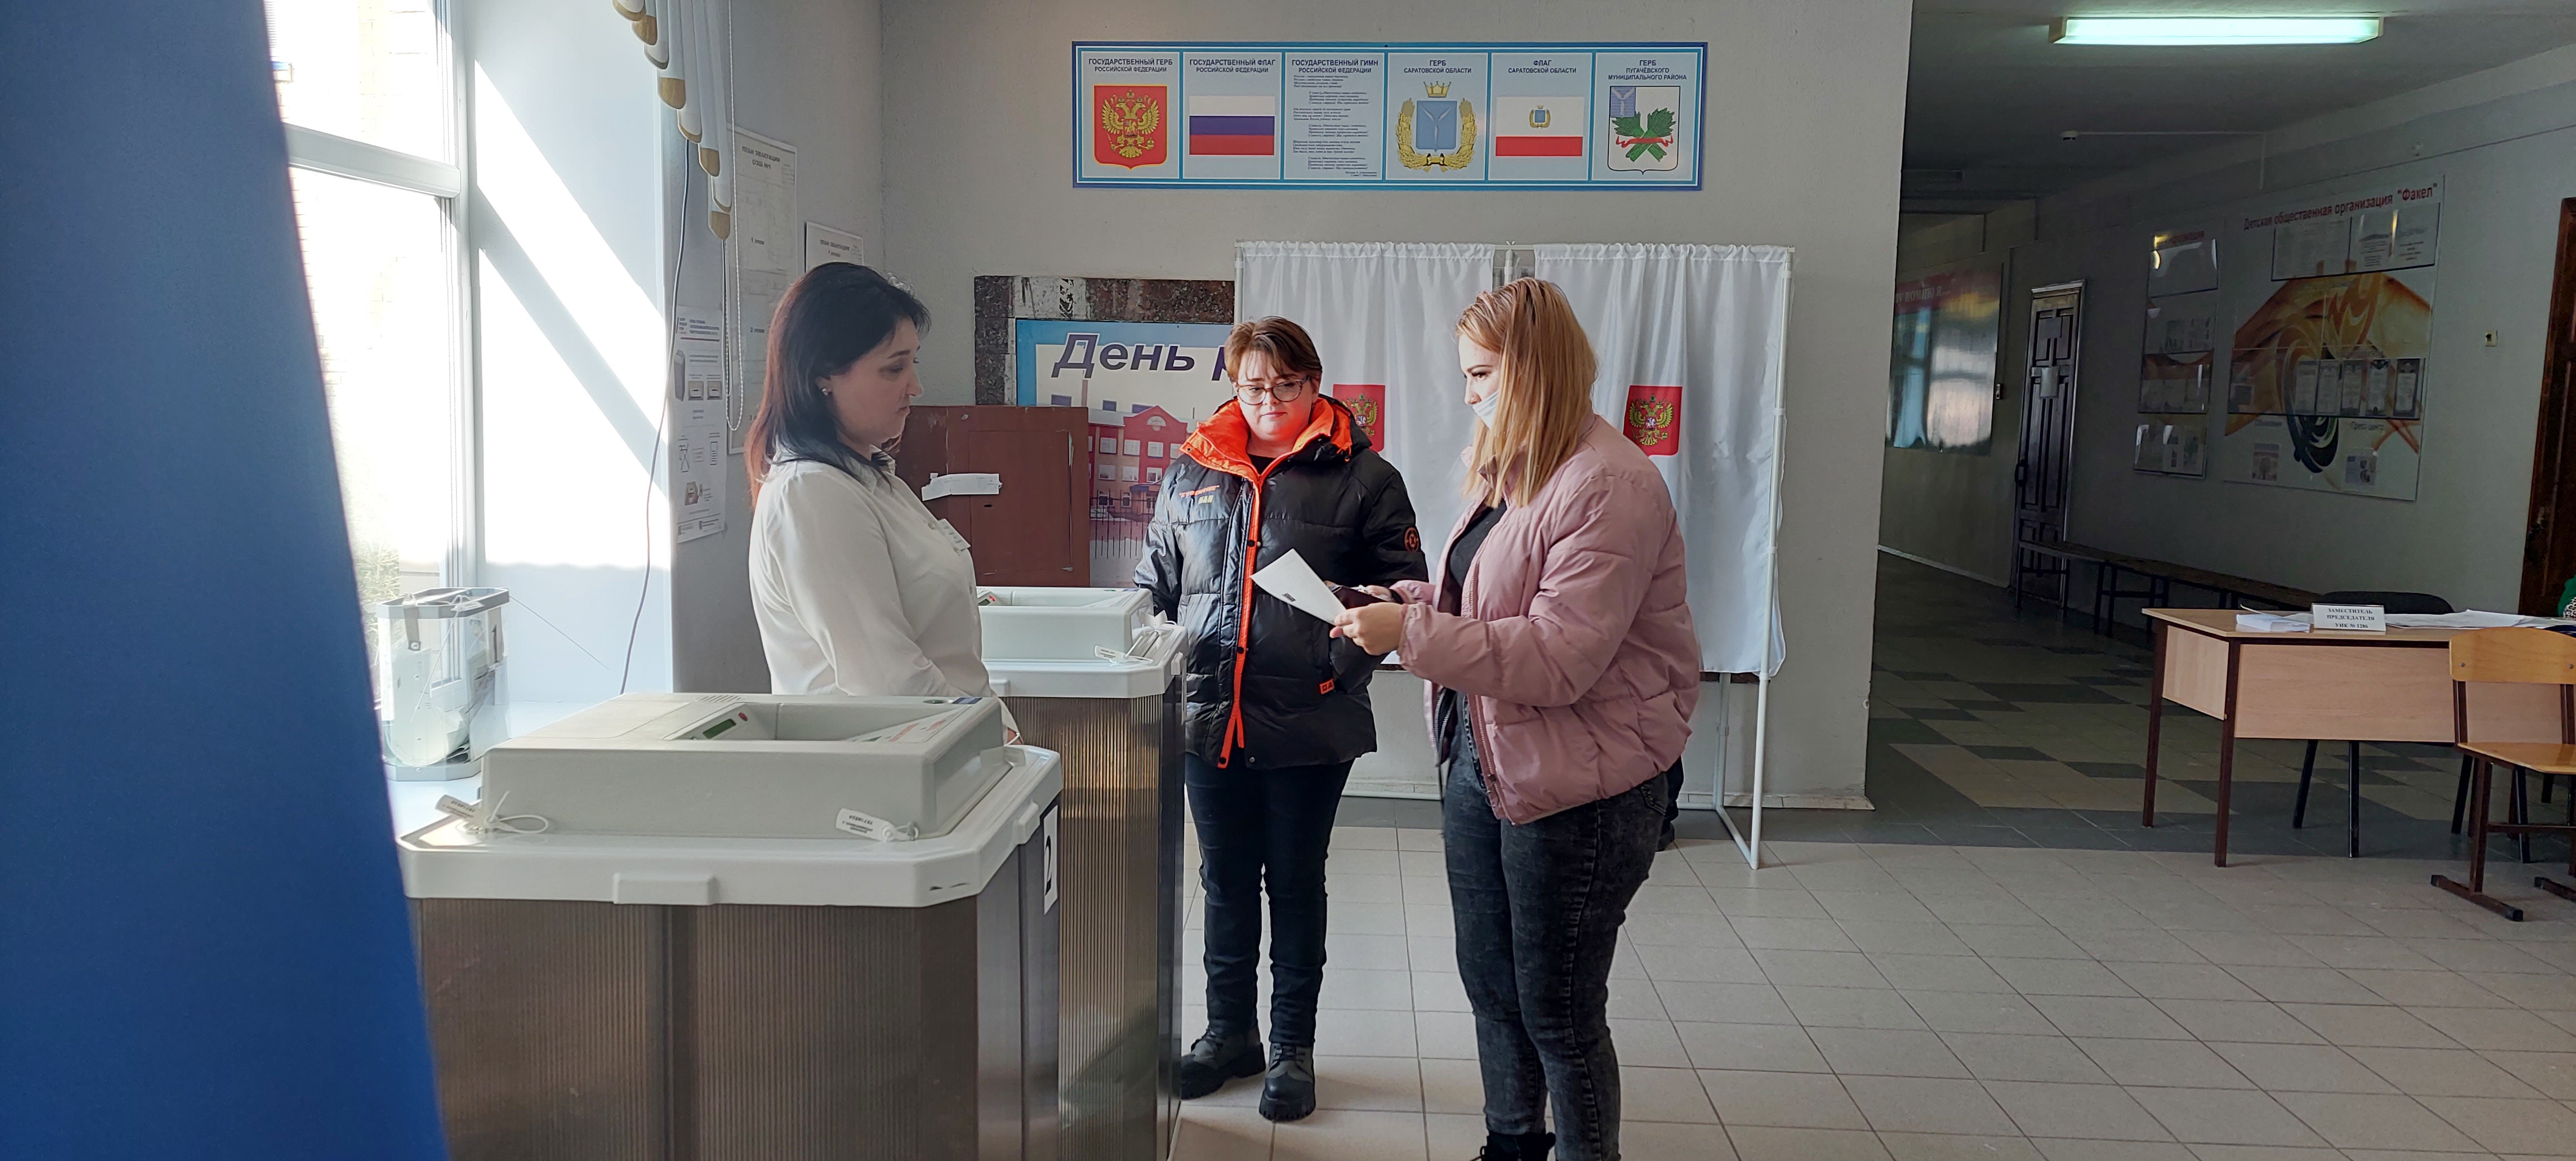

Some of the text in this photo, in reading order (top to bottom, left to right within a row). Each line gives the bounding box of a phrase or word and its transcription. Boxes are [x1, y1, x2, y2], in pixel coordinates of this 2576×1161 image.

[1189, 58, 1255, 66] ГОСУДАРСТВЕННЫЙ
[742, 146, 754, 155] ПЛАН
[2244, 214, 2272, 231] Детская
[2274, 204, 2333, 225] общественная
[2334, 194, 2393, 217] организация
[1051, 333, 1195, 379] День
[490, 624, 500, 663] 1
[1045, 835, 1052, 896] 2
